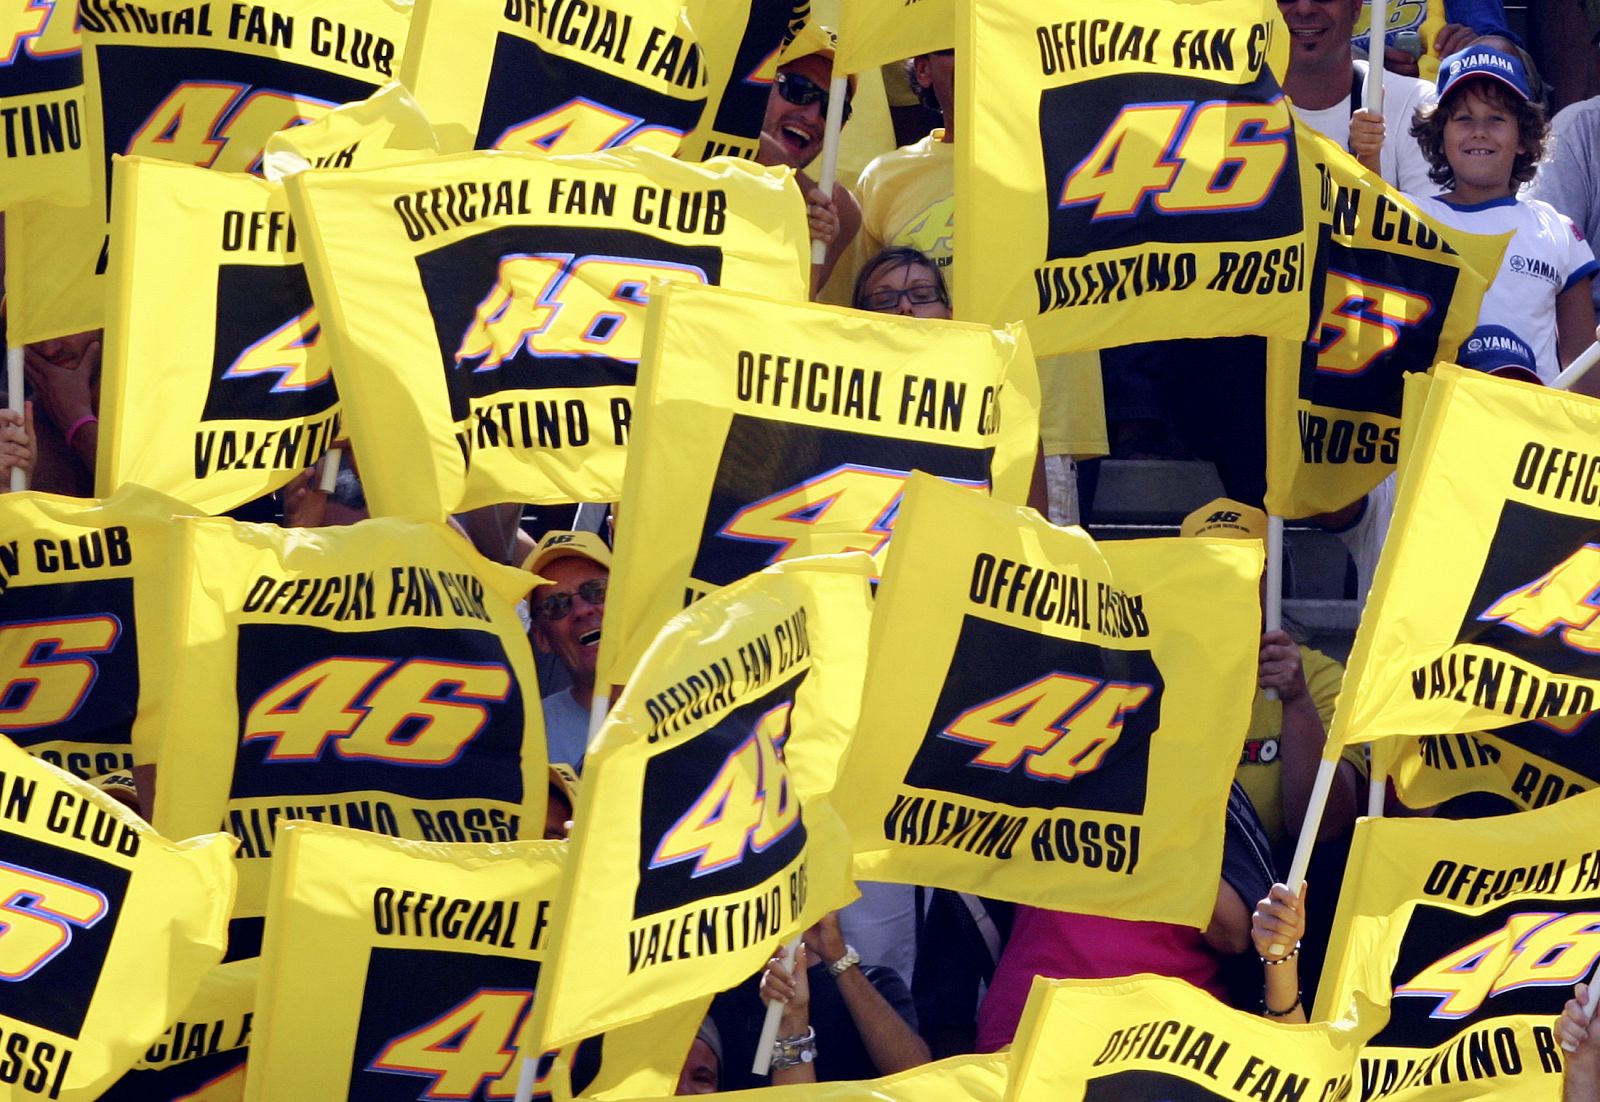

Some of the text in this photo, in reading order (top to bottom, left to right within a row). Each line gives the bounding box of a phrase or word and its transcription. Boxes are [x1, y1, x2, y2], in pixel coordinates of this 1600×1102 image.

[228, 3, 294, 49] FAN
[311, 16, 395, 77] CLUB
[1036, 19, 1162, 76] OFFICIAL
[1172, 27, 1237, 71] FAN
[1462, 54, 1514, 75] YAMAHA
[1057, 93, 1293, 225] 46
[393, 178, 728, 242] OFFICIAL FAN CLUB
[454, 252, 710, 373] 46
[1034, 242, 1305, 315] VALENTINO ROSSI
[1483, 336, 1530, 359] YAMAHA
[737, 350, 883, 422] OFFICIAL
[897, 374, 967, 432] FAN
[34, 525, 133, 574] CLUB
[242, 571, 377, 621] OFFICIAL
[388, 566, 443, 617] FAN
[969, 552, 1091, 631] OFFICIAL
[242, 655, 513, 768] 46
[645, 656, 737, 744] OFFICIAL
[738, 633, 772, 696] FAN
[936, 670, 1155, 784] 46
[46, 790, 141, 858] CLUB
[648, 700, 803, 880] 46
[1030, 818, 1142, 875] ROSSI
[374, 887, 520, 949] OFFICIAL
[628, 882, 782, 976] VALENTINO
[1092, 1020, 1231, 1081] OFFICIAL
